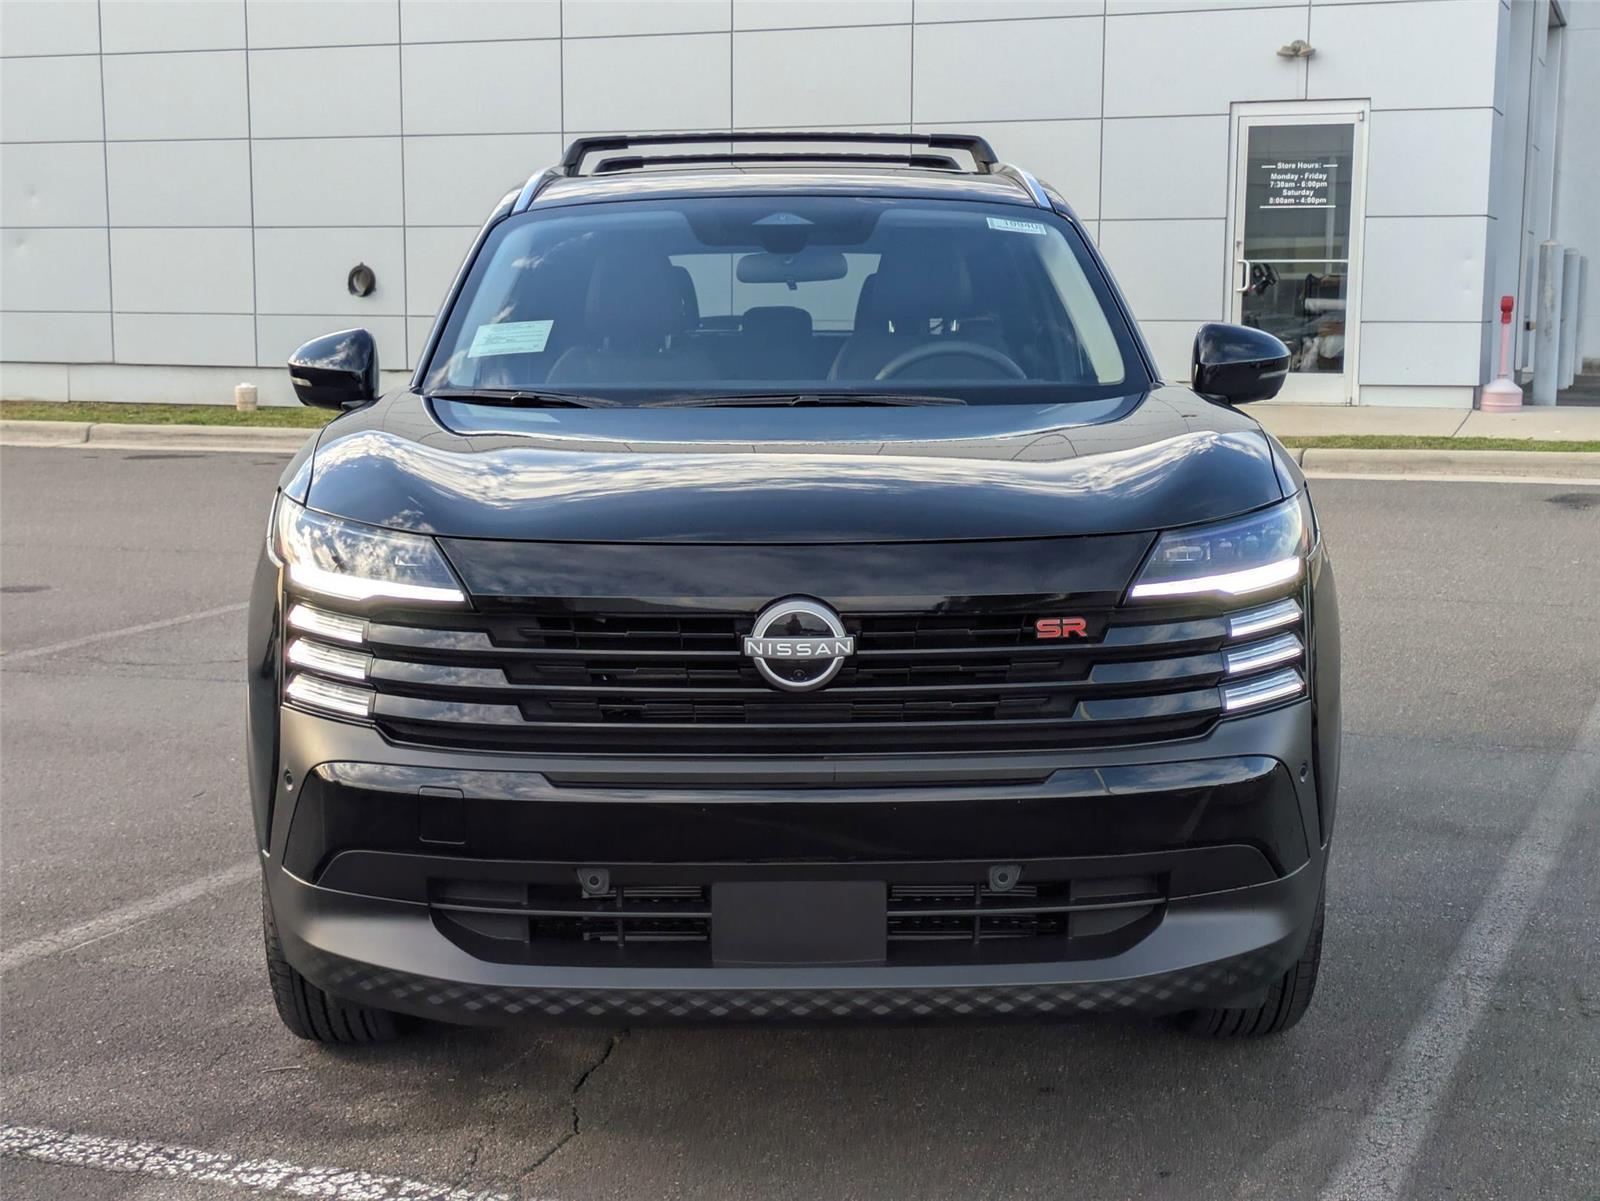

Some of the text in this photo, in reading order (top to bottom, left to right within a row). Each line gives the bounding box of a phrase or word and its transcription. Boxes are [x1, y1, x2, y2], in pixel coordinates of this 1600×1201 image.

[1297, 161, 1322, 169] Hours:
[1270, 172, 1299, 181] Monday
[1304, 172, 1328, 180] Friday
[1036, 618, 1087, 638] SR
[747, 641, 851, 656] NISSAN
